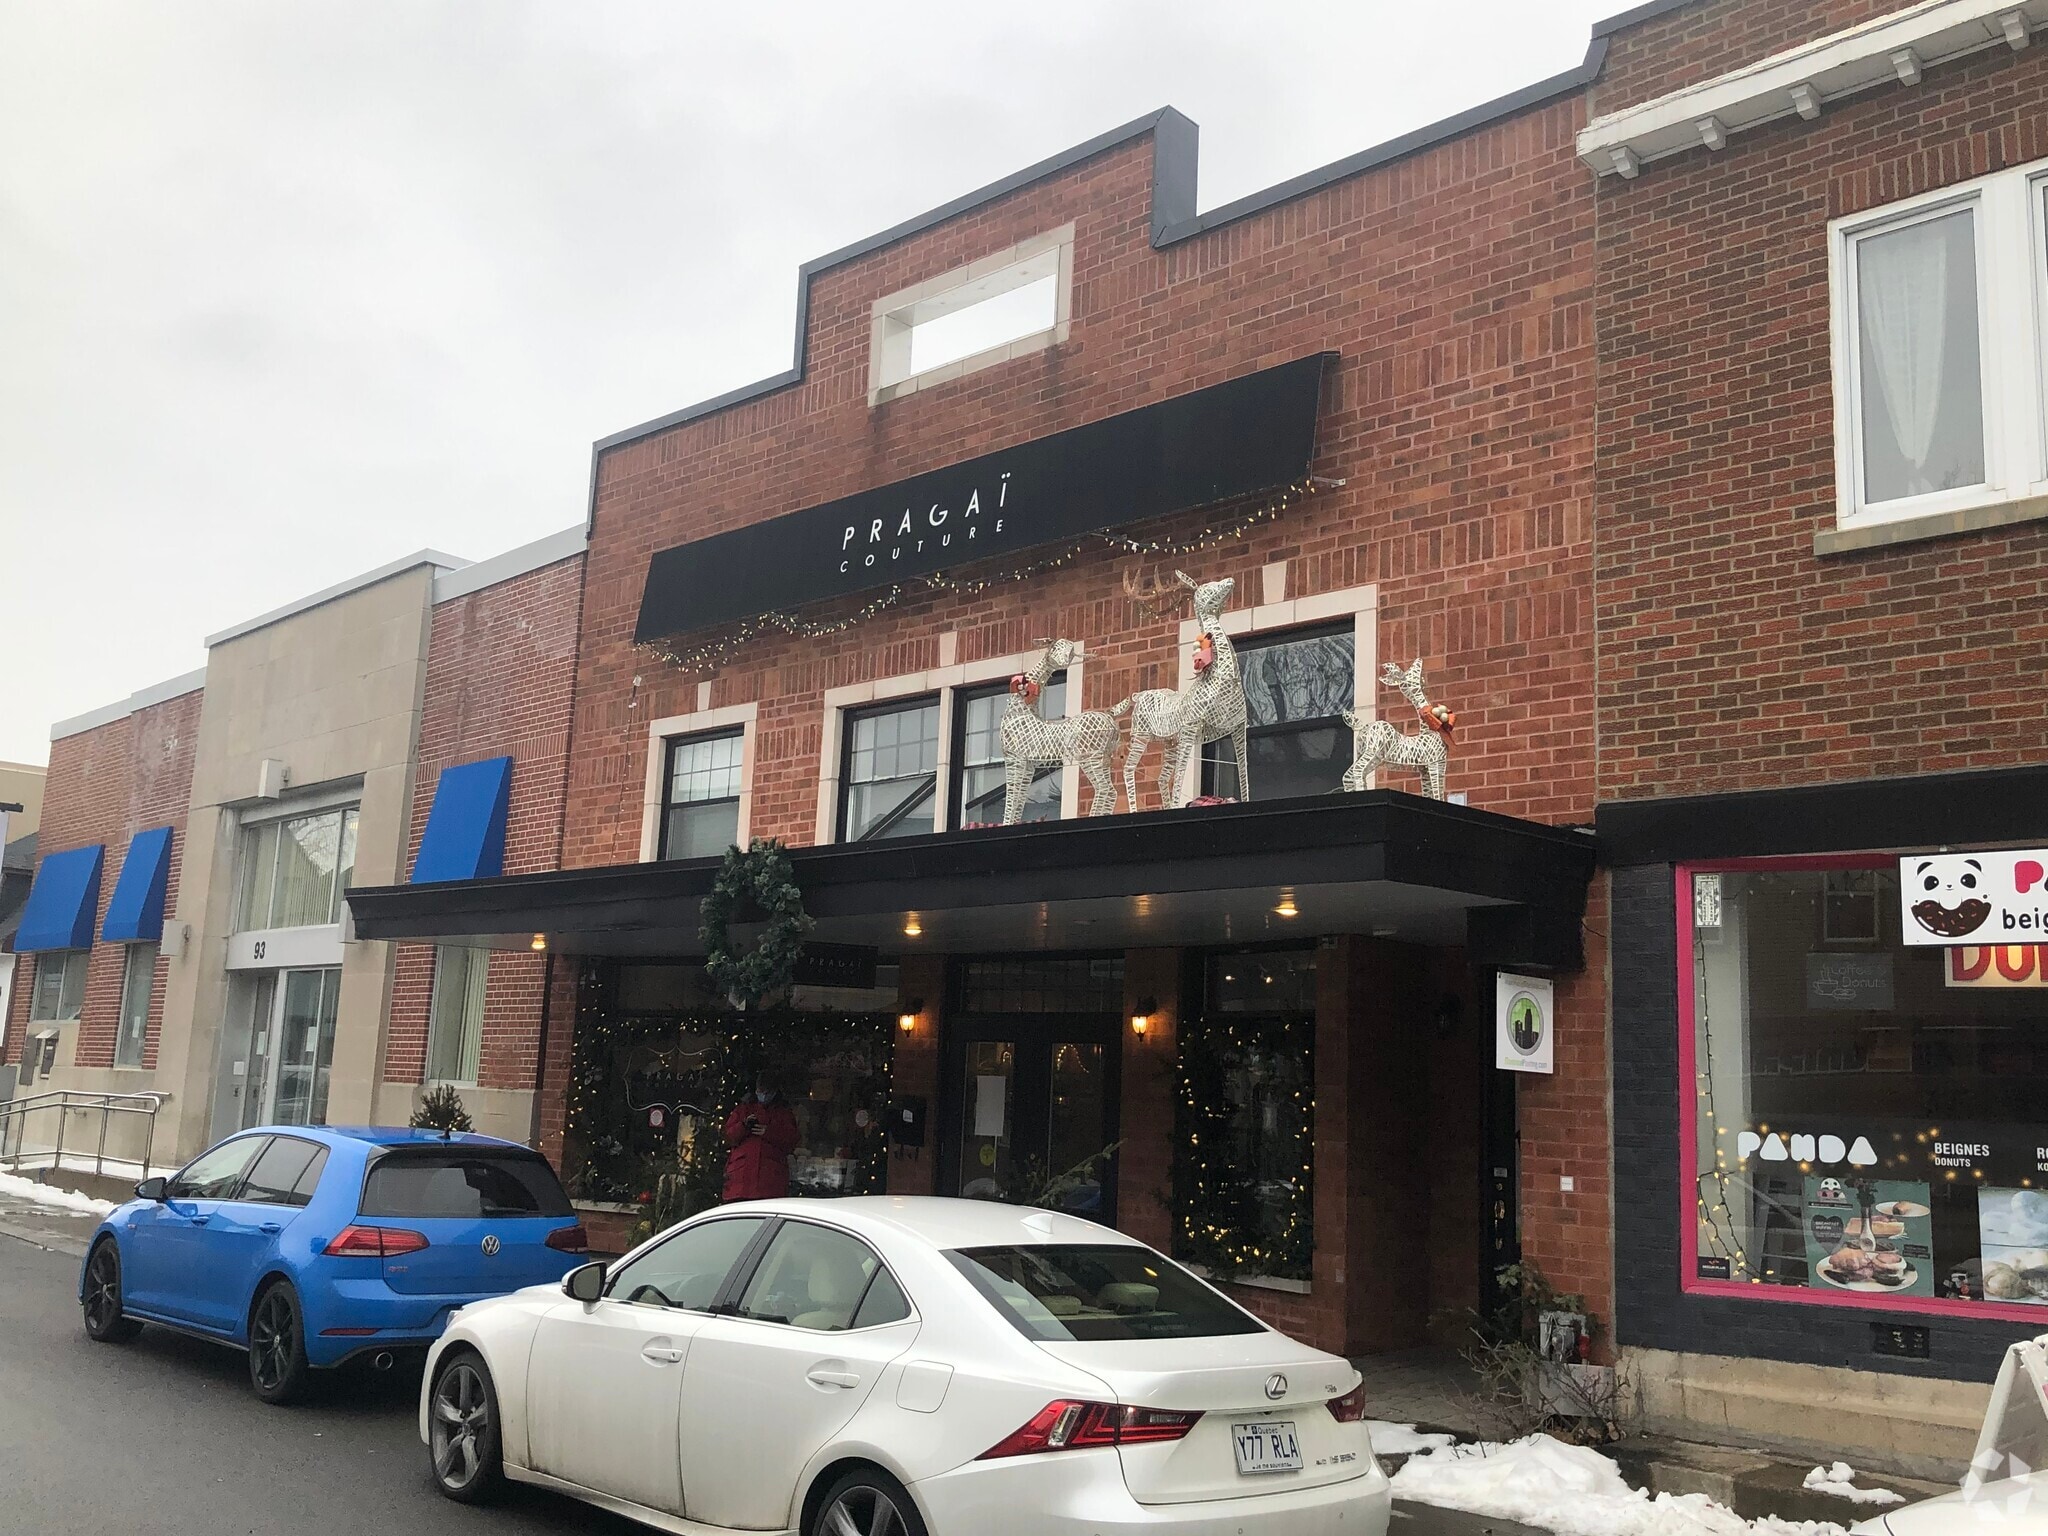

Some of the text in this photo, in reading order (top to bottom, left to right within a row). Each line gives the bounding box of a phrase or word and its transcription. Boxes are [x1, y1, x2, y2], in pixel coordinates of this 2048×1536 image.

[842, 472, 1011, 551] PRAGAÏ
[840, 519, 1003, 573] COUTURE
[2014, 860, 2048, 894] P
[253, 941, 266, 960] 93
[1737, 1131, 1878, 1165] PANDA
[1934, 1142, 1990, 1157] BEIGNES
[1934, 1157, 1971, 1168] DONUTS
[1237, 1435, 1263, 1461] Y77
[1271, 1433, 1299, 1459] RLA
